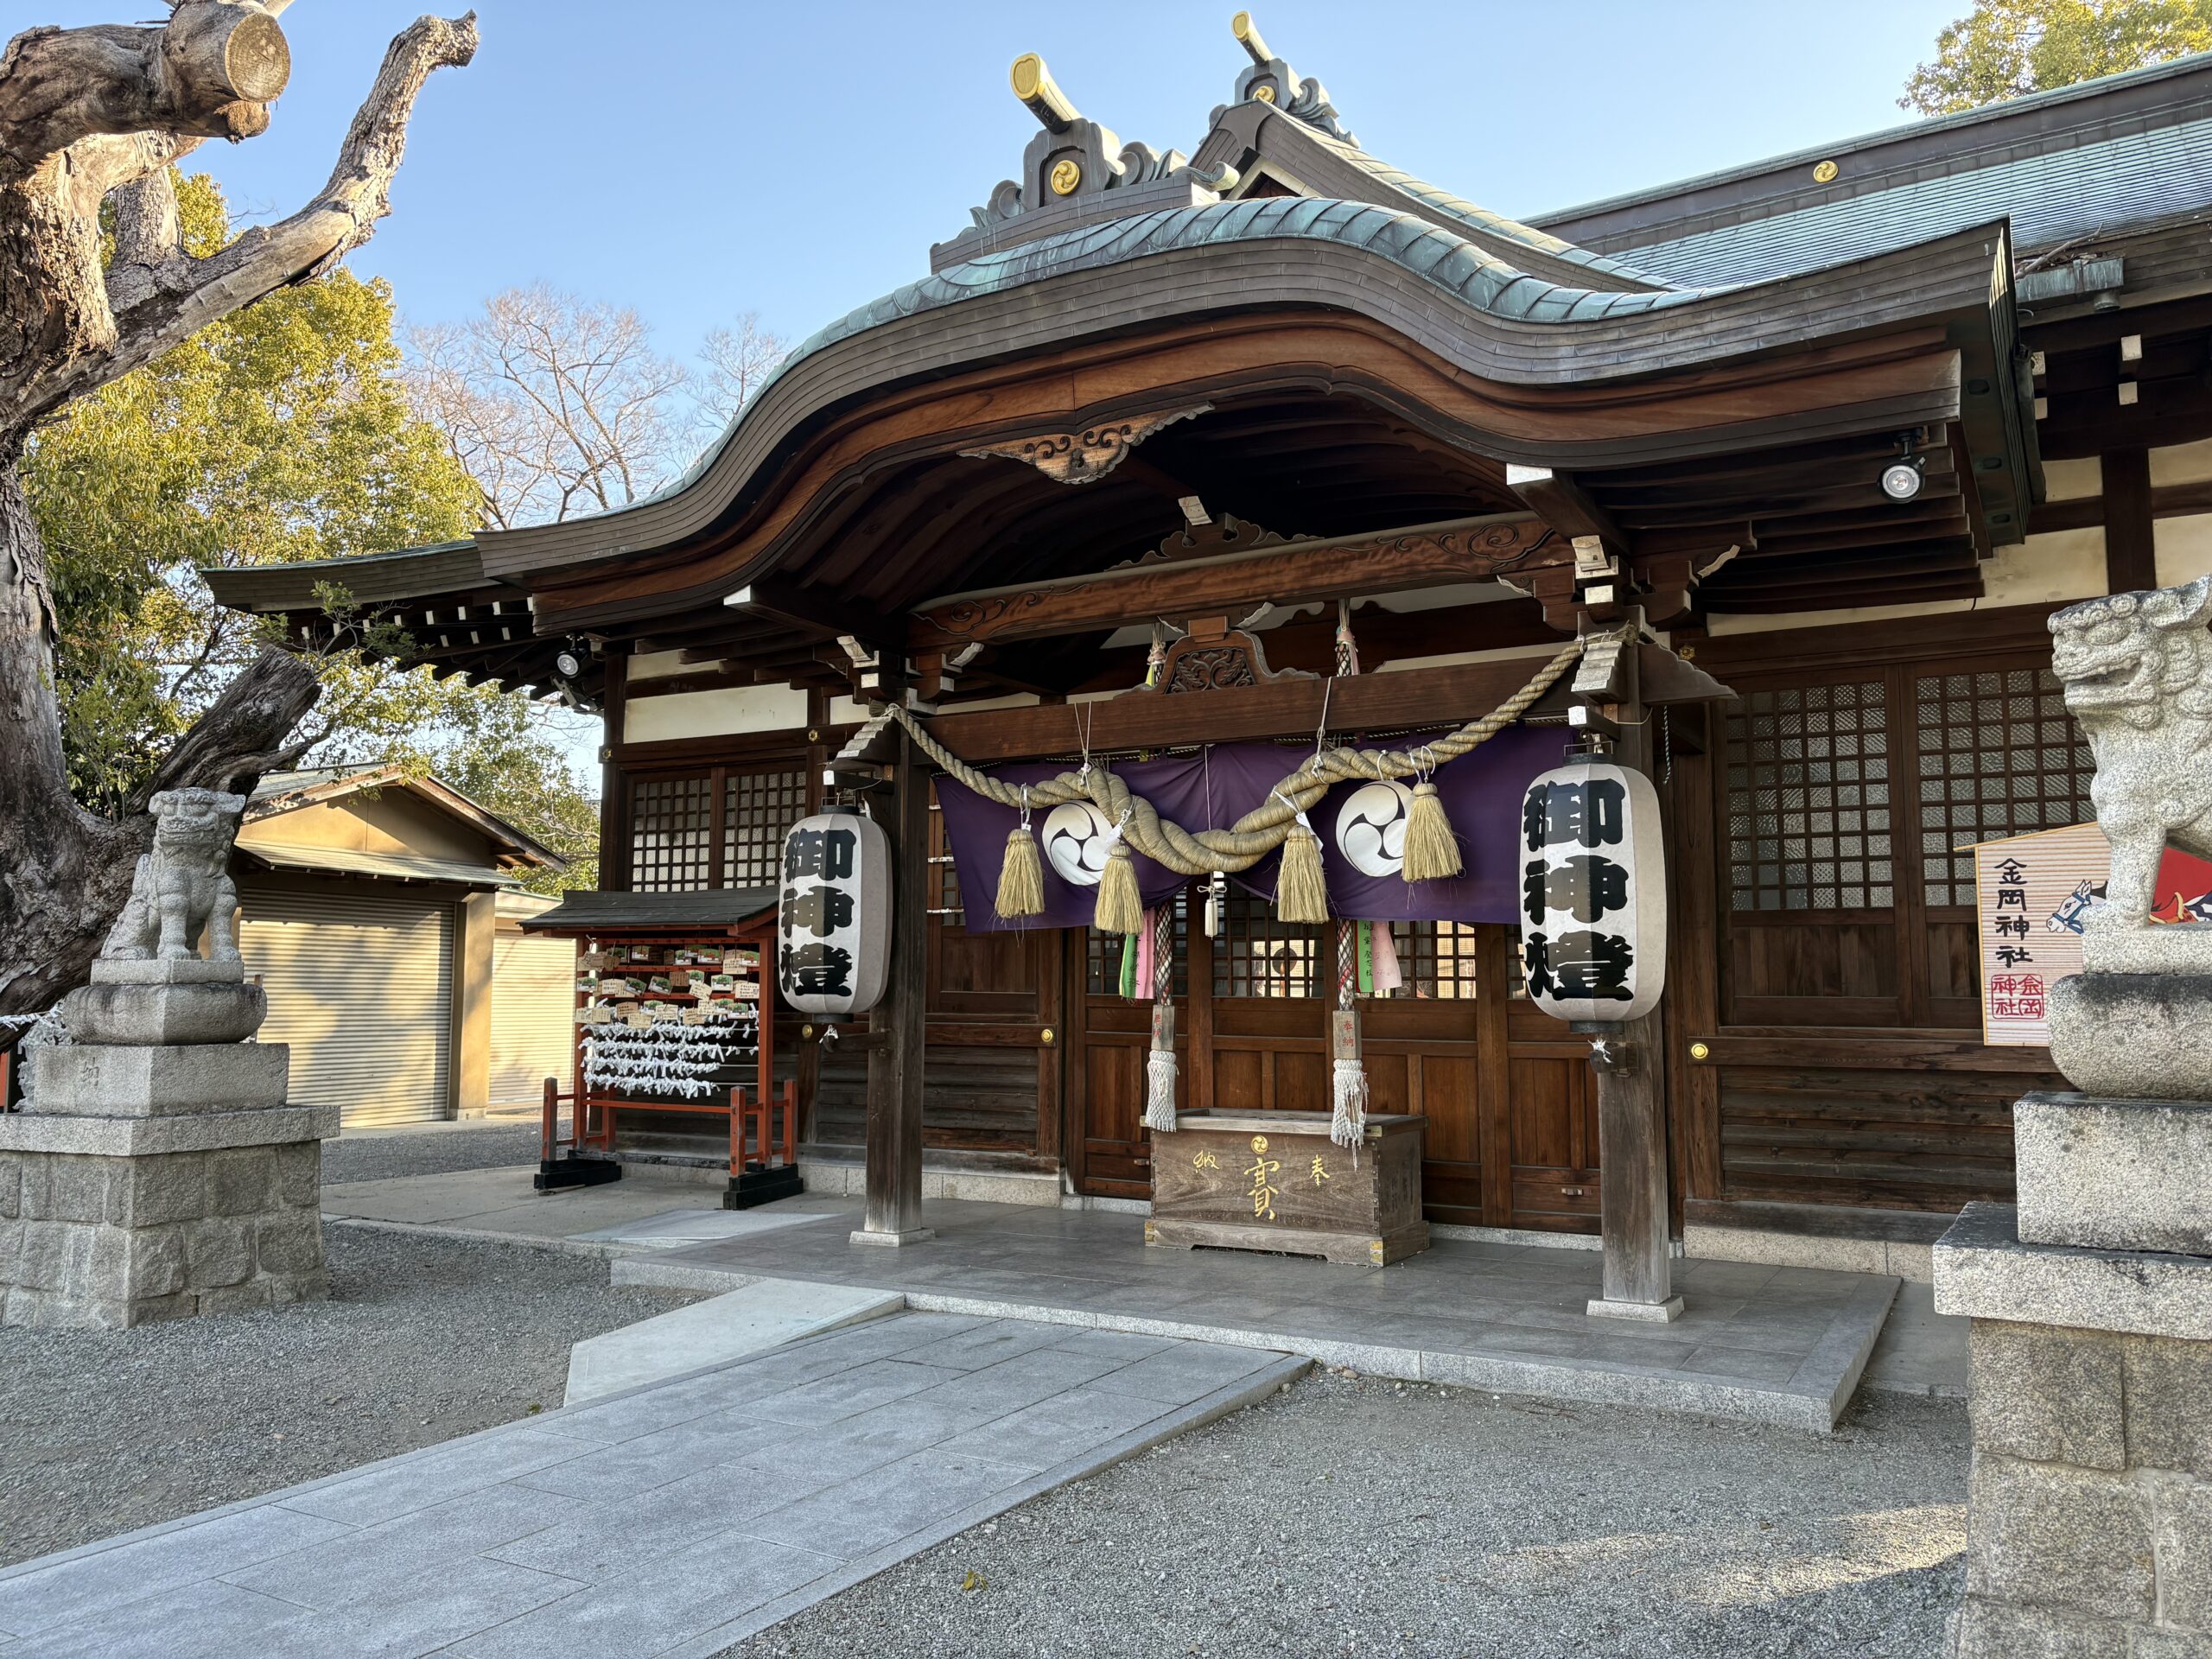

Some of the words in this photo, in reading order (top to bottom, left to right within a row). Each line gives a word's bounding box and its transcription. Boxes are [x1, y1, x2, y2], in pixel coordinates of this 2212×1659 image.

[780, 828, 857, 997] 御神燈
[1523, 779, 1635, 1001] 御神燈
[1993, 858, 2034, 968] 金岡神社
[1343, 1020, 1355, 1047] 奉納
[1993, 976, 2019, 1016] 神社
